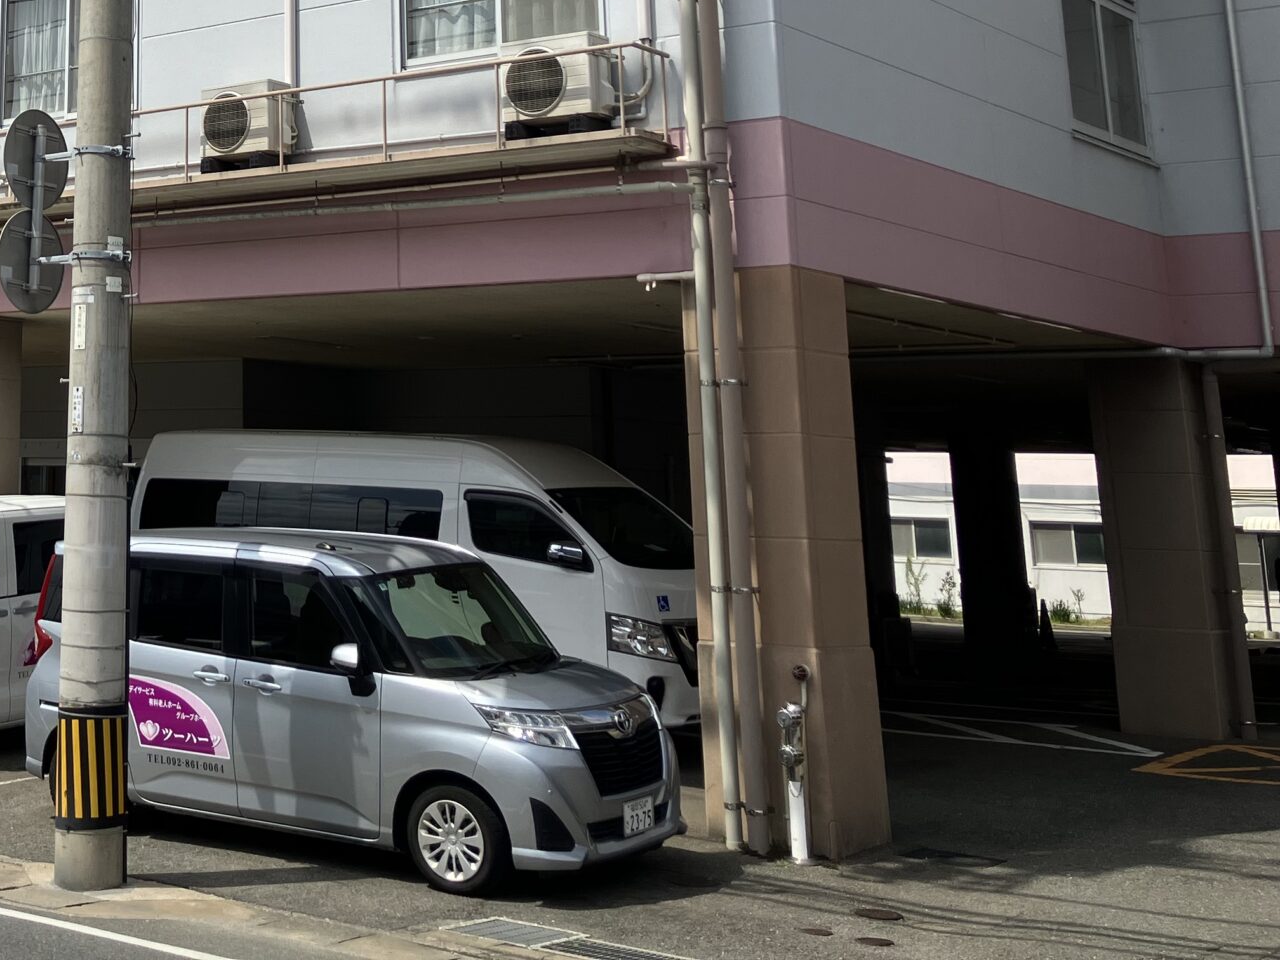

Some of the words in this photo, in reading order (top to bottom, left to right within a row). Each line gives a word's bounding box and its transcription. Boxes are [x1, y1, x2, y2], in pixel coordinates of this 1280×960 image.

[161, 727, 222, 747] ツーハーツ
